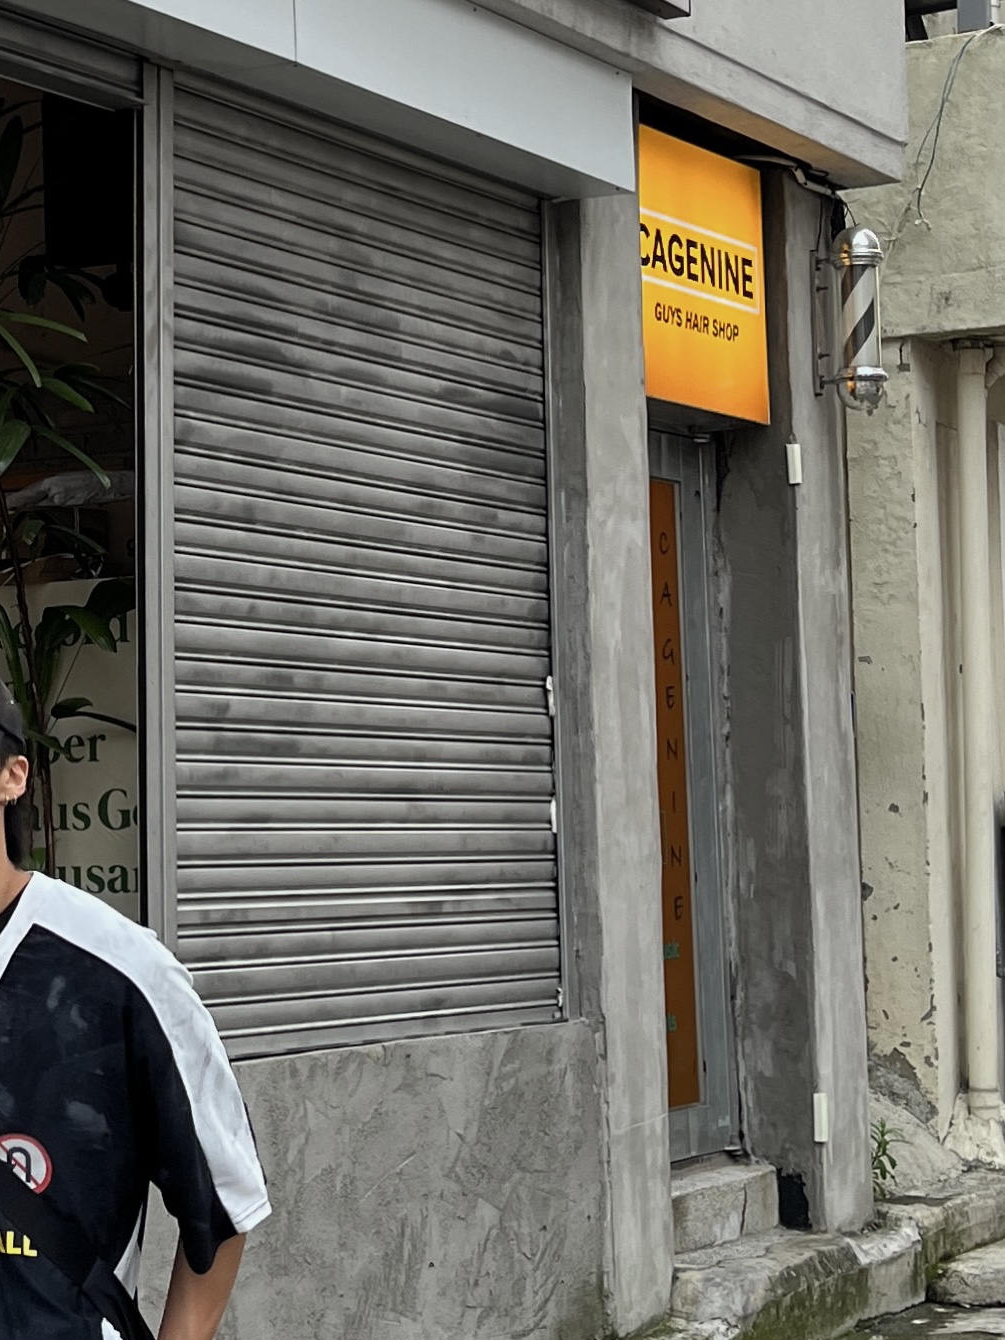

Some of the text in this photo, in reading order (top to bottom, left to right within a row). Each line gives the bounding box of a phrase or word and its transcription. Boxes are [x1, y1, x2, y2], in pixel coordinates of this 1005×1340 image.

[654, 301, 740, 342] GUYS HAIR SHOP
